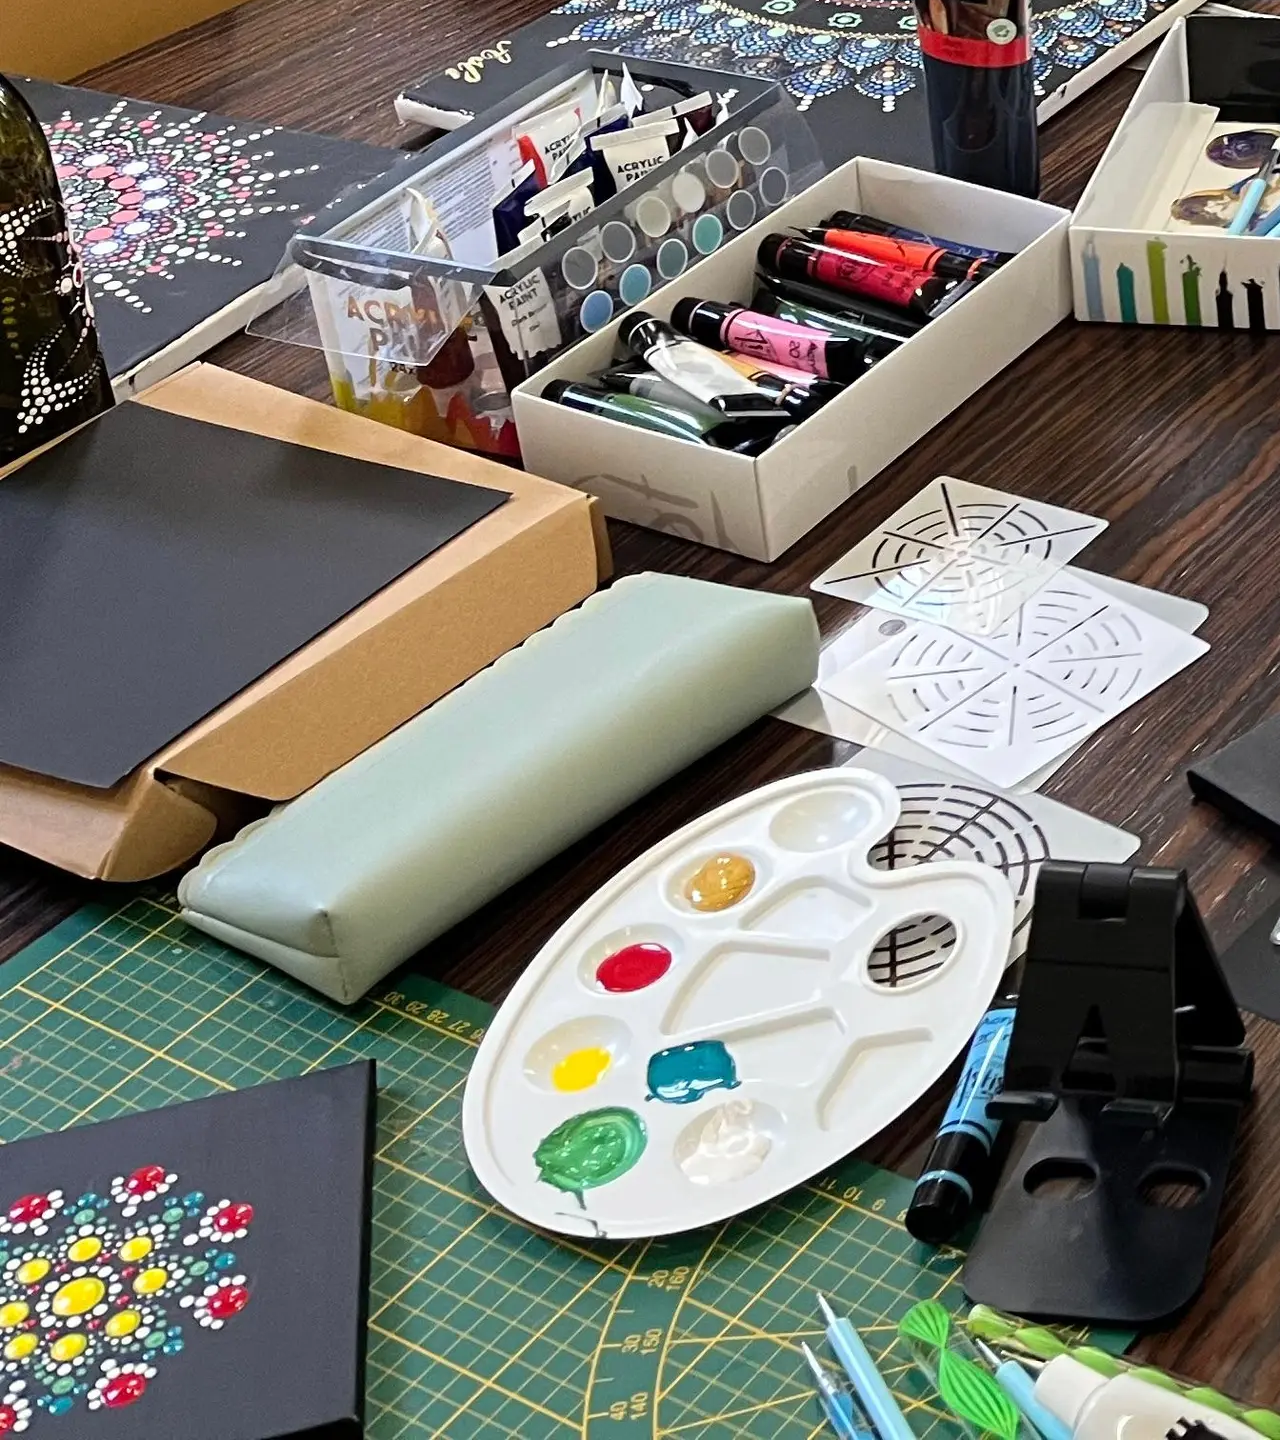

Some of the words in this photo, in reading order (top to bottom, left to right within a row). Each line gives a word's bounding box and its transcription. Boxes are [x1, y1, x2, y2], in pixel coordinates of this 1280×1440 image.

[617, 155, 665, 174] ACRYLIC
[427, 1010, 450, 1023] 28
[450, 1020, 471, 1033] 27
[843, 1186, 864, 1202] 10
[648, 1270, 669, 1288] 20
[666, 1266, 690, 1292] 160
[621, 1334, 642, 1353] 30
[640, 1328, 663, 1355] 150
[610, 1401, 628, 1421] 40
[630, 1392, 648, 1420] 140
